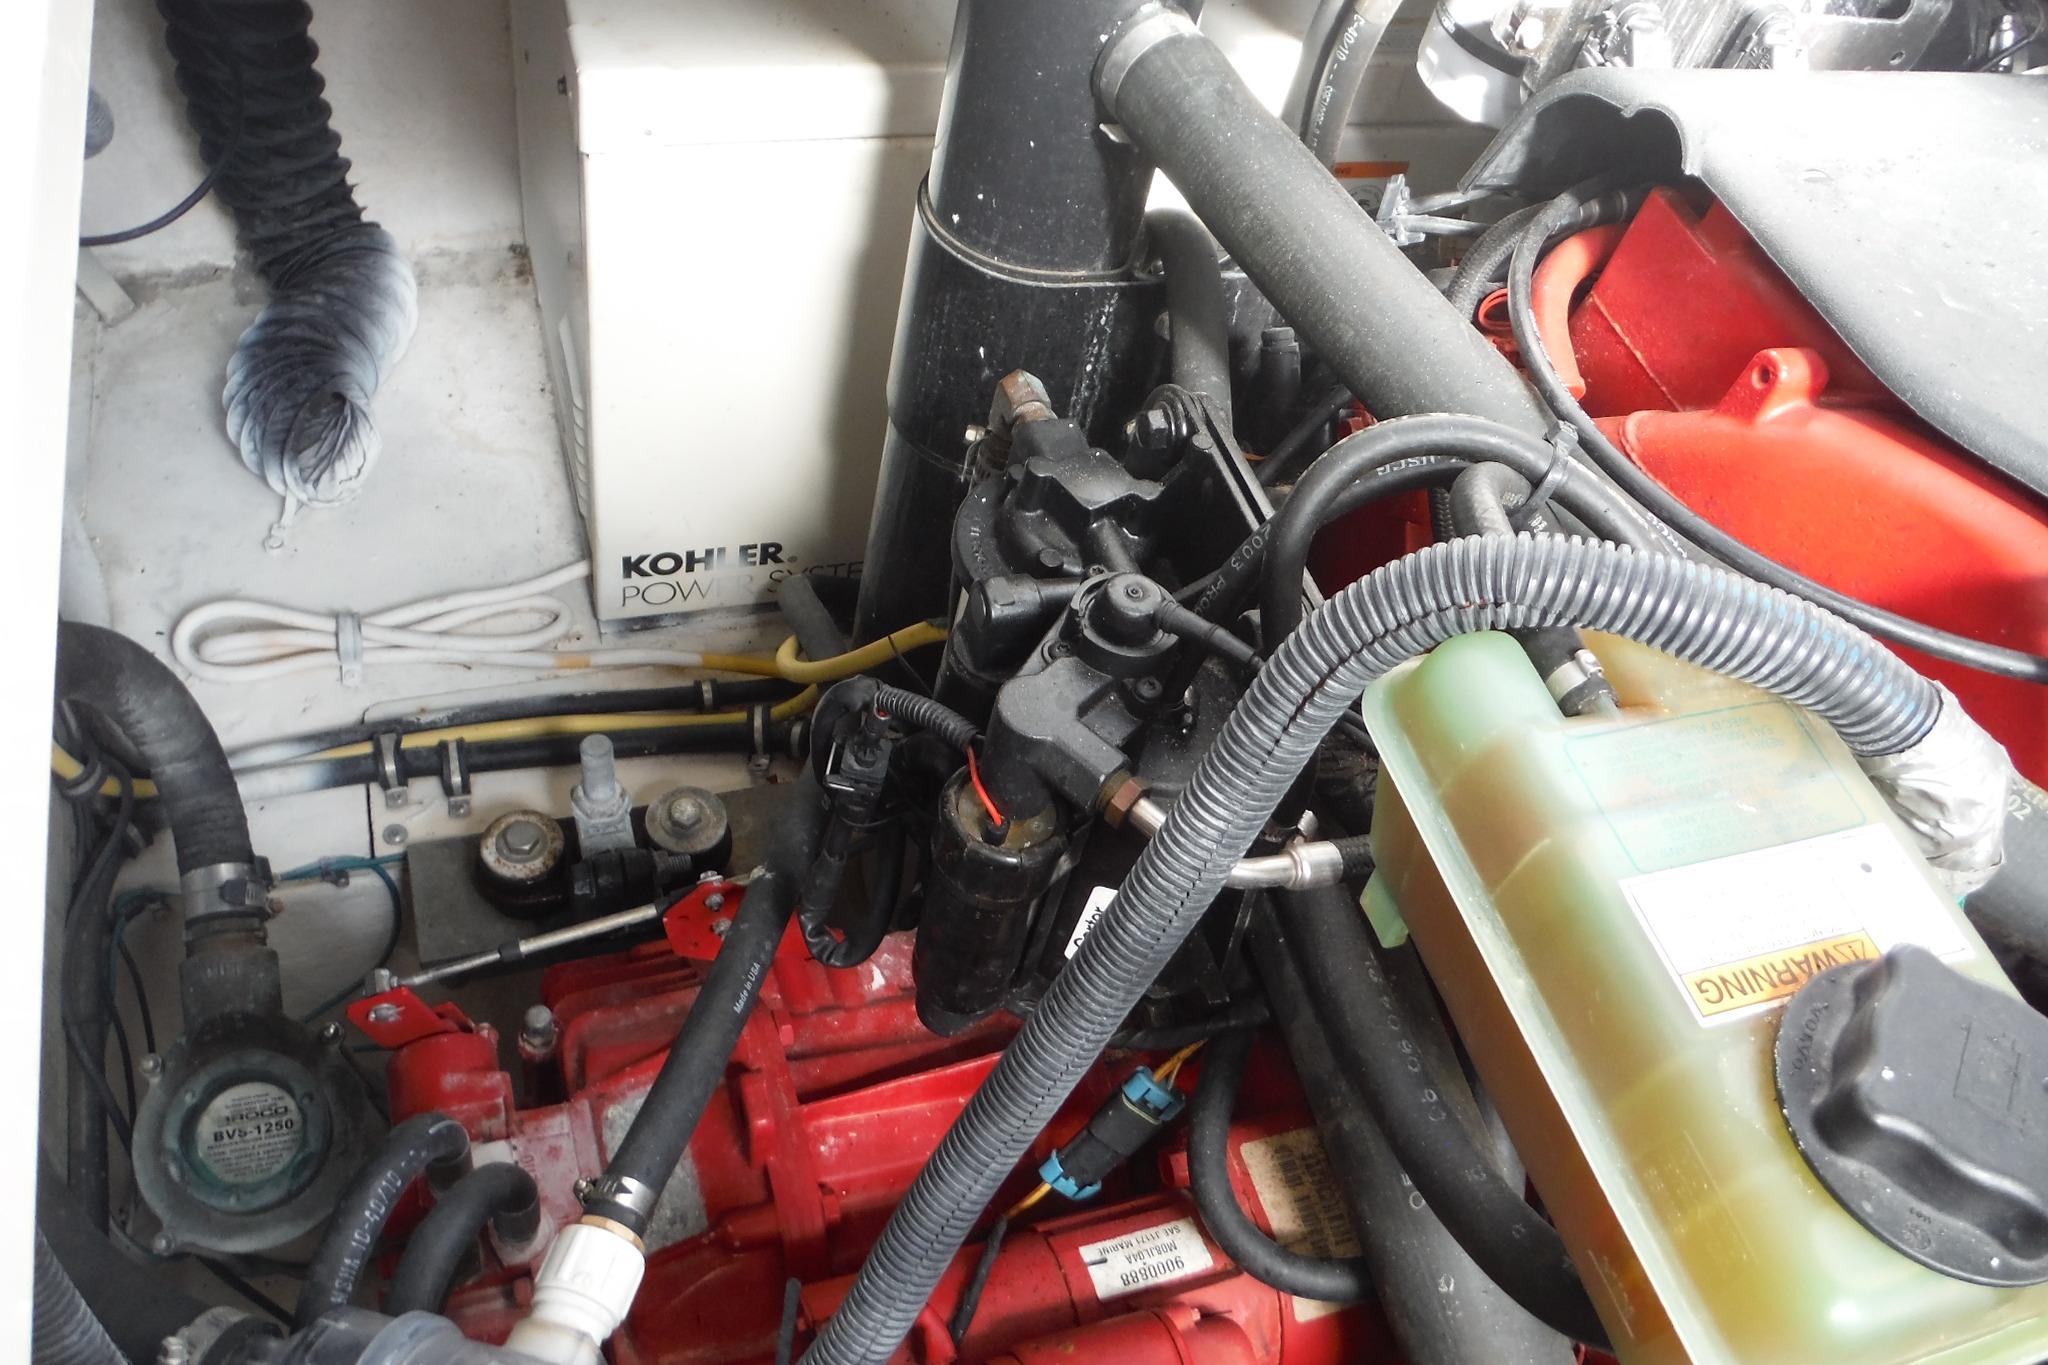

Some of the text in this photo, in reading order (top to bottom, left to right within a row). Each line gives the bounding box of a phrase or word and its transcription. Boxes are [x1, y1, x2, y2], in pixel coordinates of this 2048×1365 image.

[748, 962, 761, 981] USA
[1695, 948, 1840, 1005] WARNING
[1164, 1224, 1181, 1236] SAE
[1098, 1239, 1134, 1256] MARINE
[1120, 1255, 1185, 1287] 9000888
